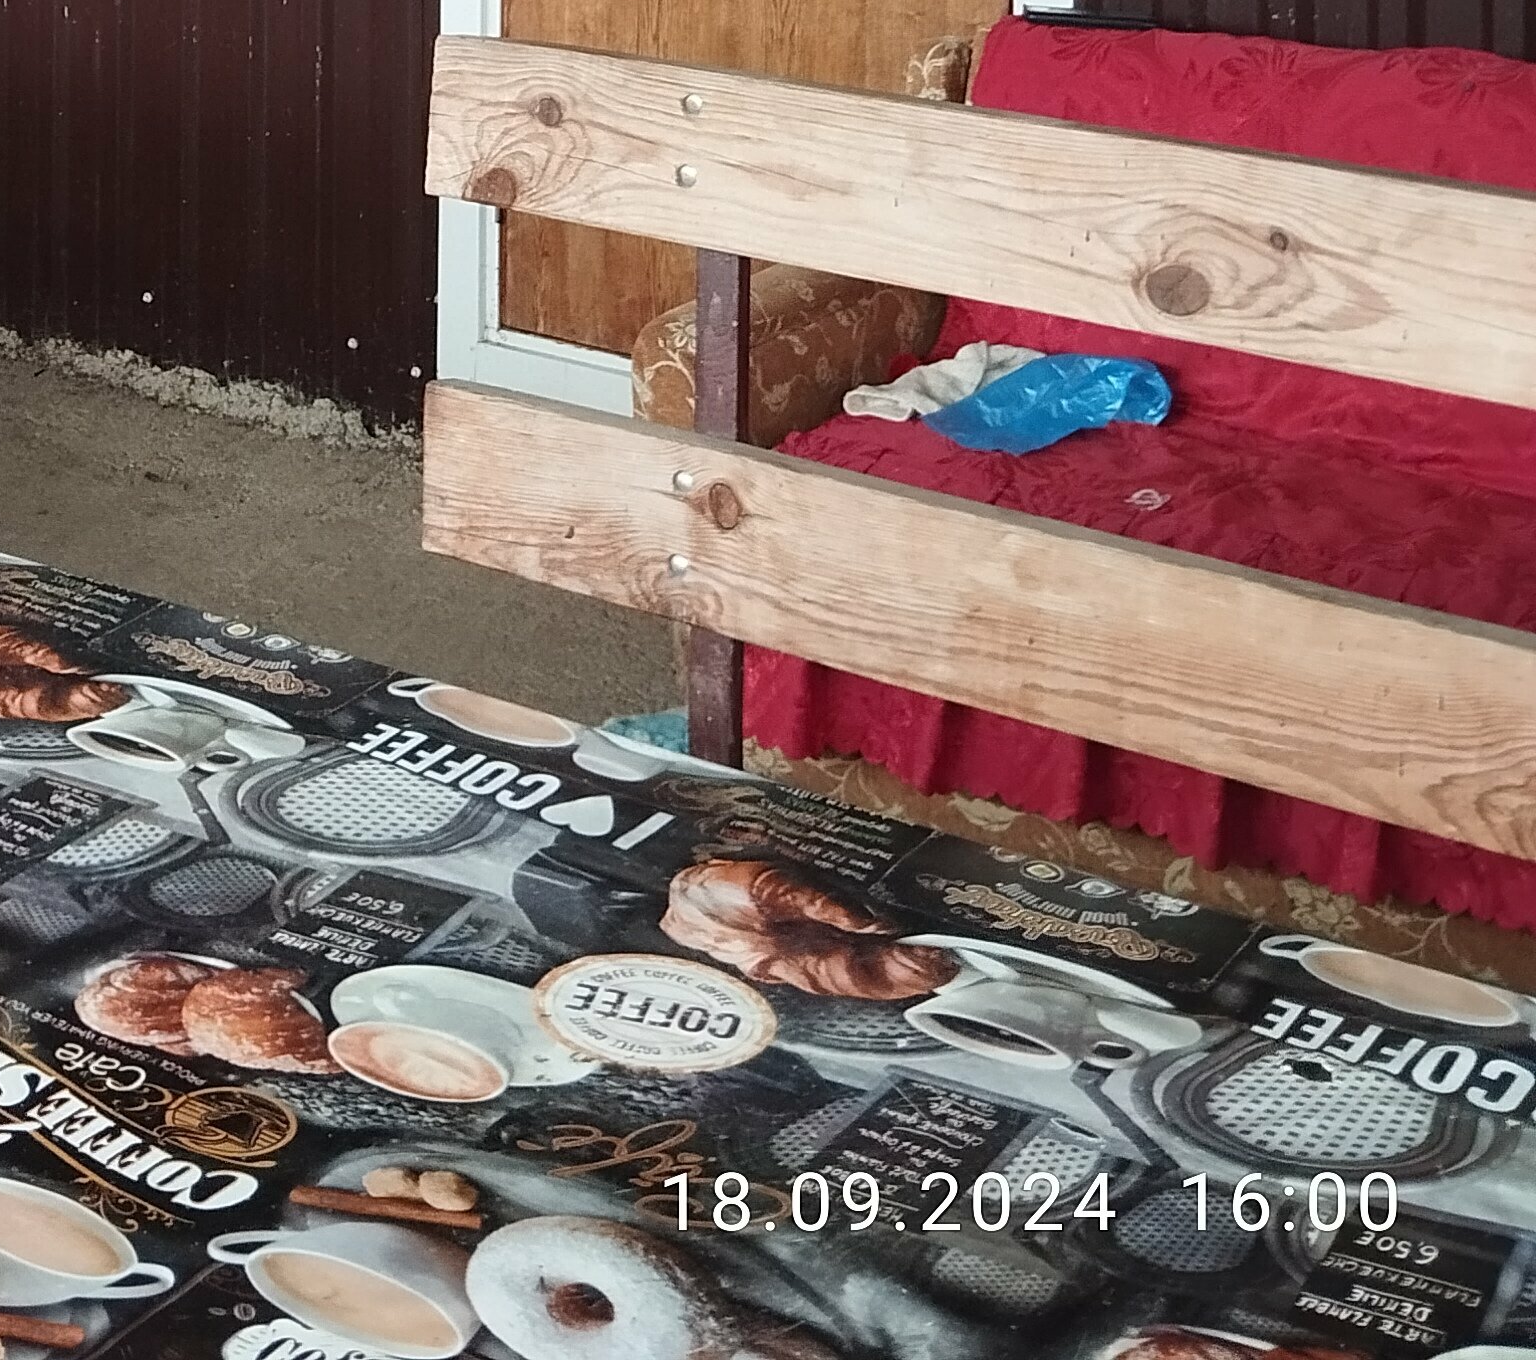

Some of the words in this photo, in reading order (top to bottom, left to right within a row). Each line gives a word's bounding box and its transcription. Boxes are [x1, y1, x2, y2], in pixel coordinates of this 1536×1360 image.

[346, 722, 560, 811] COFFEE
[565, 981, 741, 1039] COFFEE
[1251, 997, 1536, 1116] COFFEE
[27, 1088, 259, 1211] COFFEE
